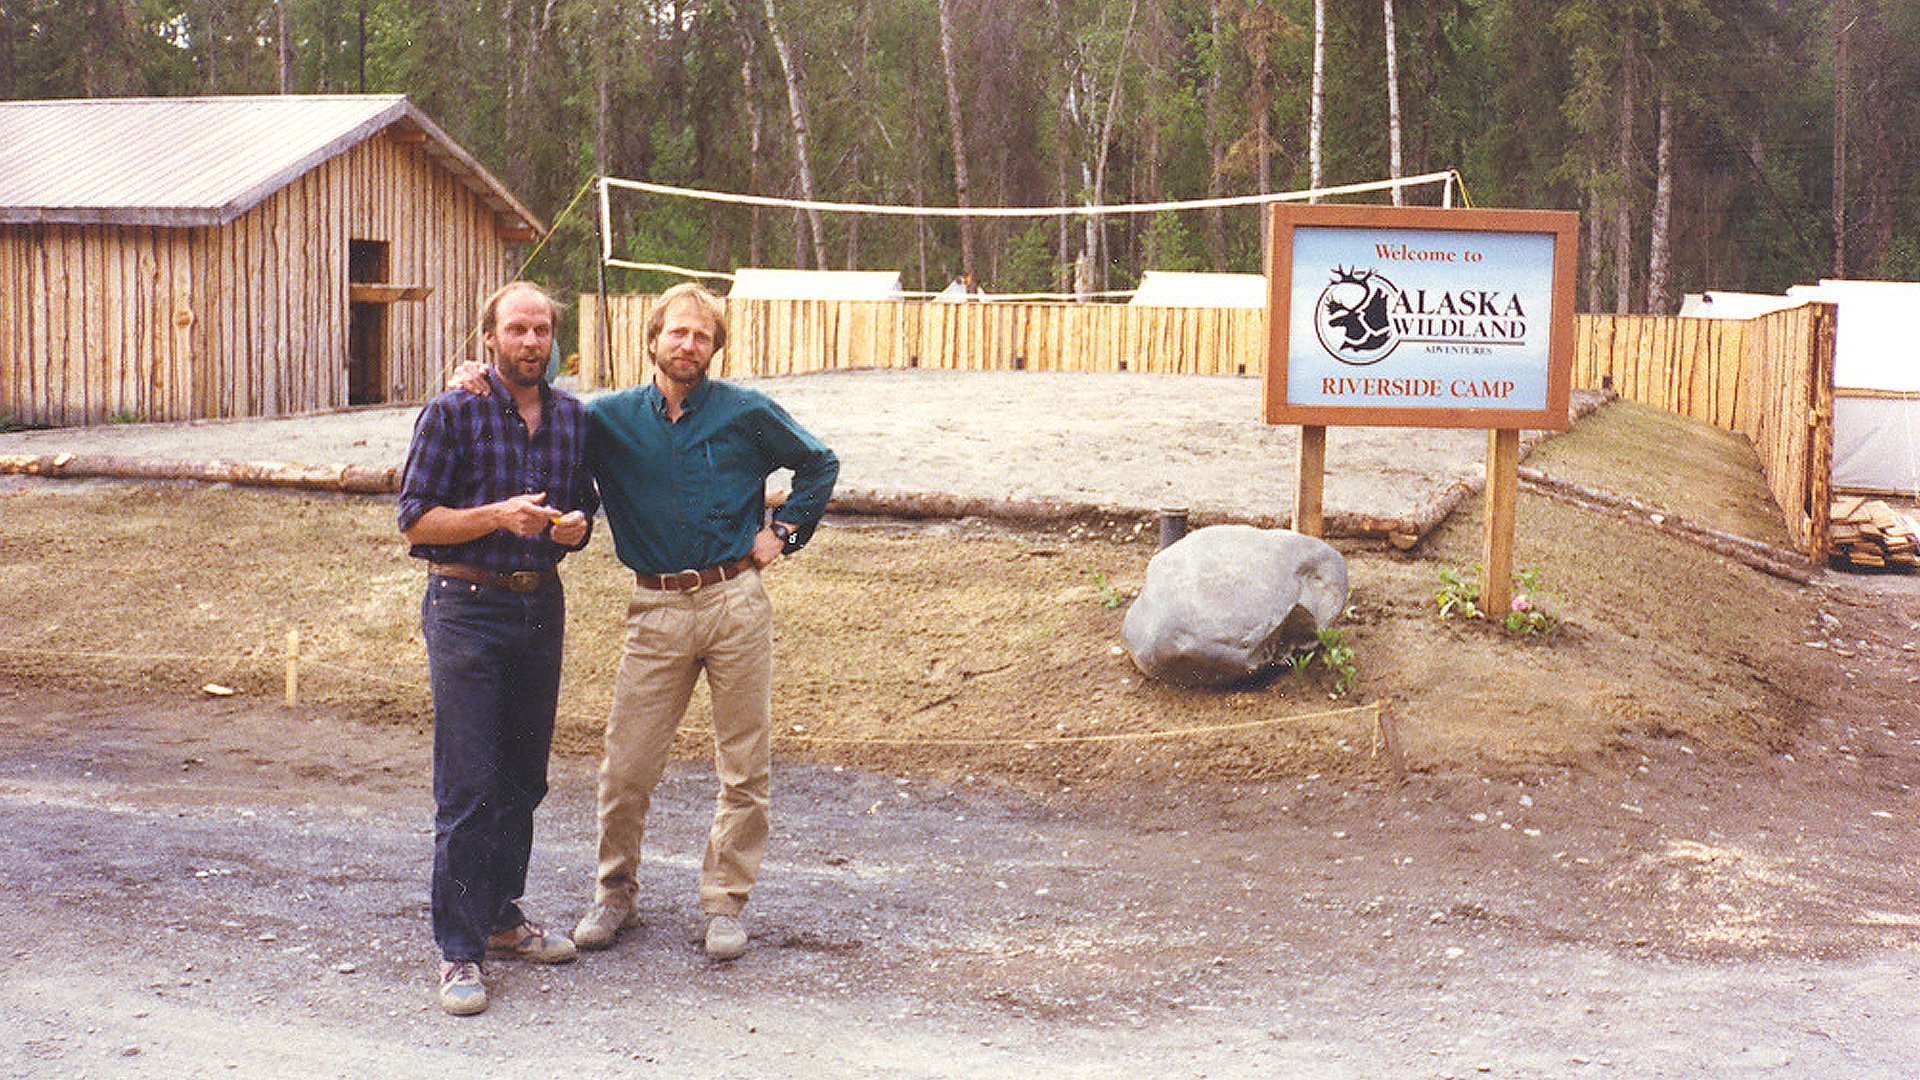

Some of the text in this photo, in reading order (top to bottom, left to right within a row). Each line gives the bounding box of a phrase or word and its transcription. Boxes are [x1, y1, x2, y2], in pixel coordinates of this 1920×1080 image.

[1375, 244, 1483, 263] Welcome to
[1392, 289, 1525, 317] ALASKA
[1391, 317, 1526, 339] WILDLAND
[1424, 345, 1493, 355] ADVENTURES
[1322, 377, 1515, 398] RIVERSIDE CAMP
